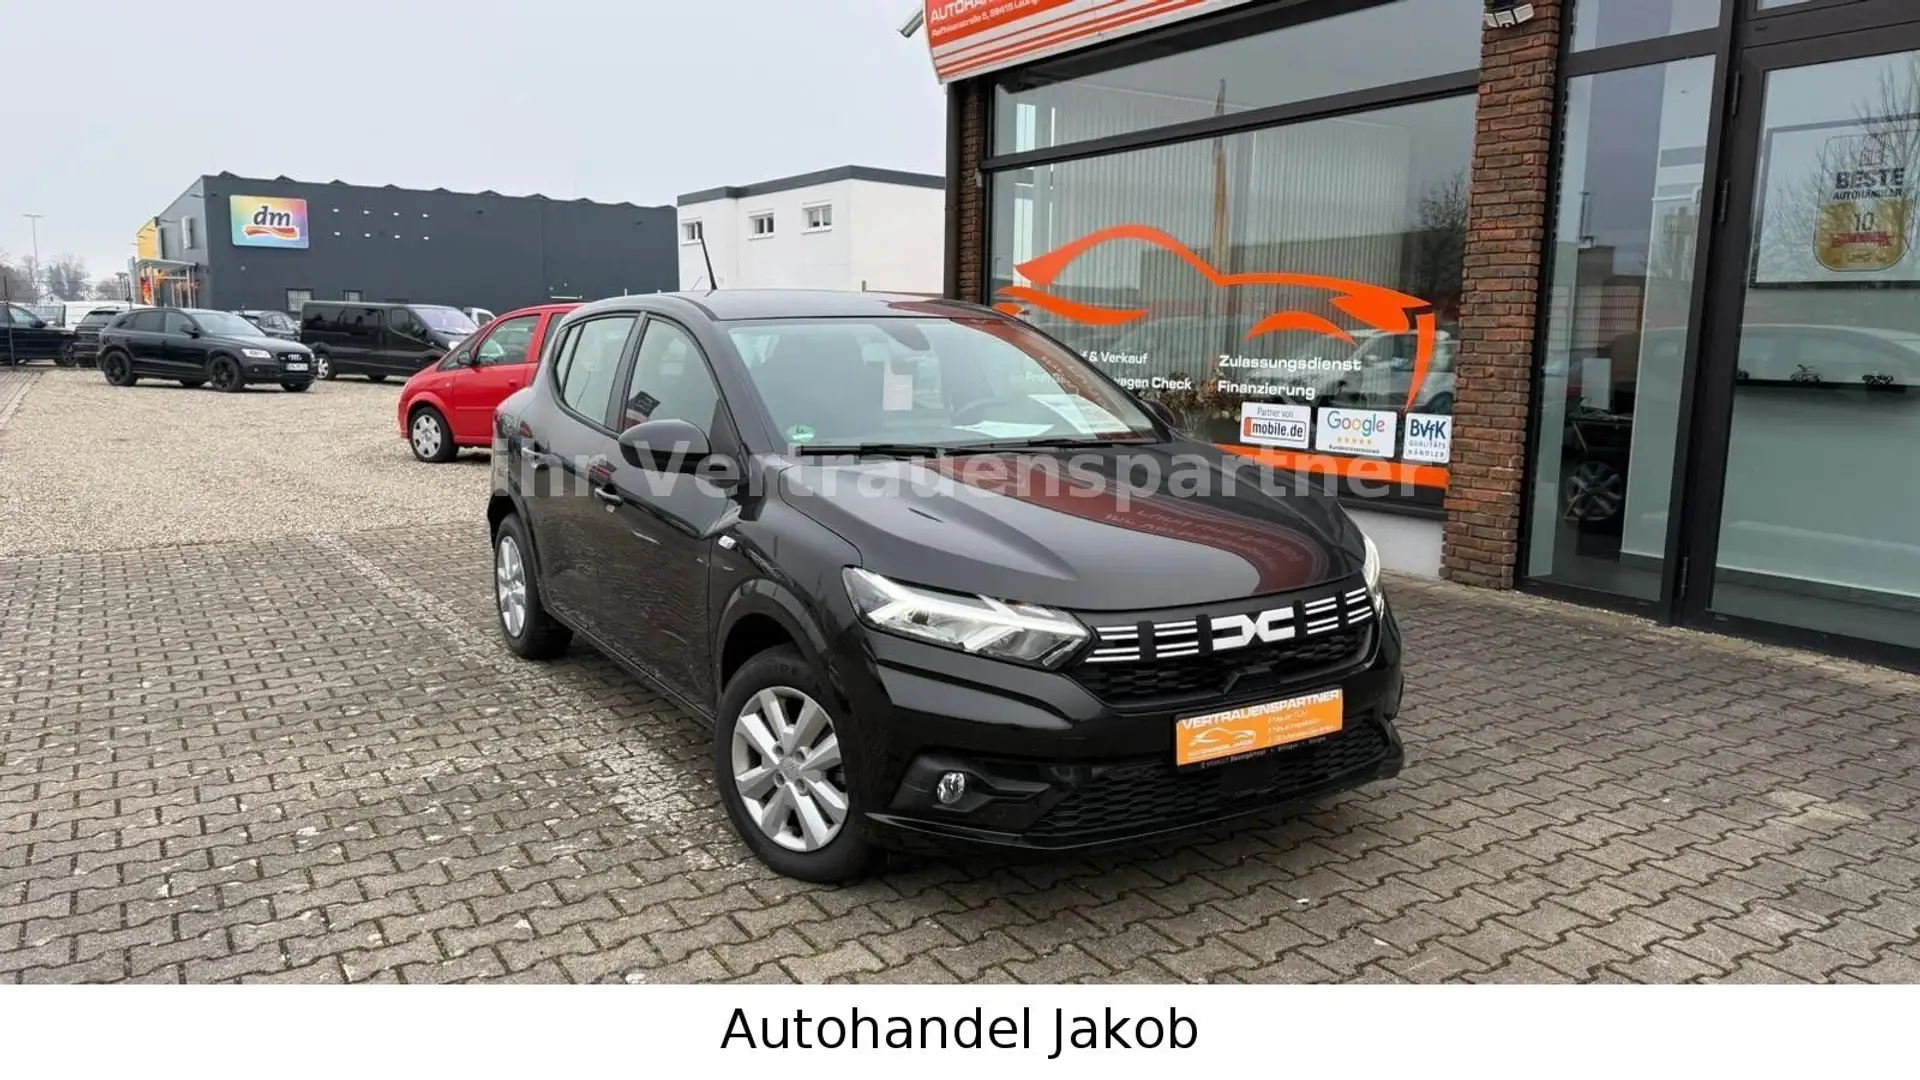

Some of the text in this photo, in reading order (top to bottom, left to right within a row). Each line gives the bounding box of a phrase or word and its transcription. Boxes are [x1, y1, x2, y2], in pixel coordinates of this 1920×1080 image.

[1835, 167, 1904, 189] BESTE
[253, 205, 291, 226] dm
[1853, 212, 1875, 231] 10
[1100, 351, 1148, 364] Verkauf
[1219, 355, 1361, 372] Zulassungsdienst
[1151, 377, 1192, 390] Check
[1217, 380, 1316, 400] Finanzierung
[1257, 407, 1281, 418] Partner
[1252, 422, 1304, 438] mobile.de
[1327, 410, 1385, 437] Google
[1182, 690, 1340, 730] VERTRAUENSPARTNER
